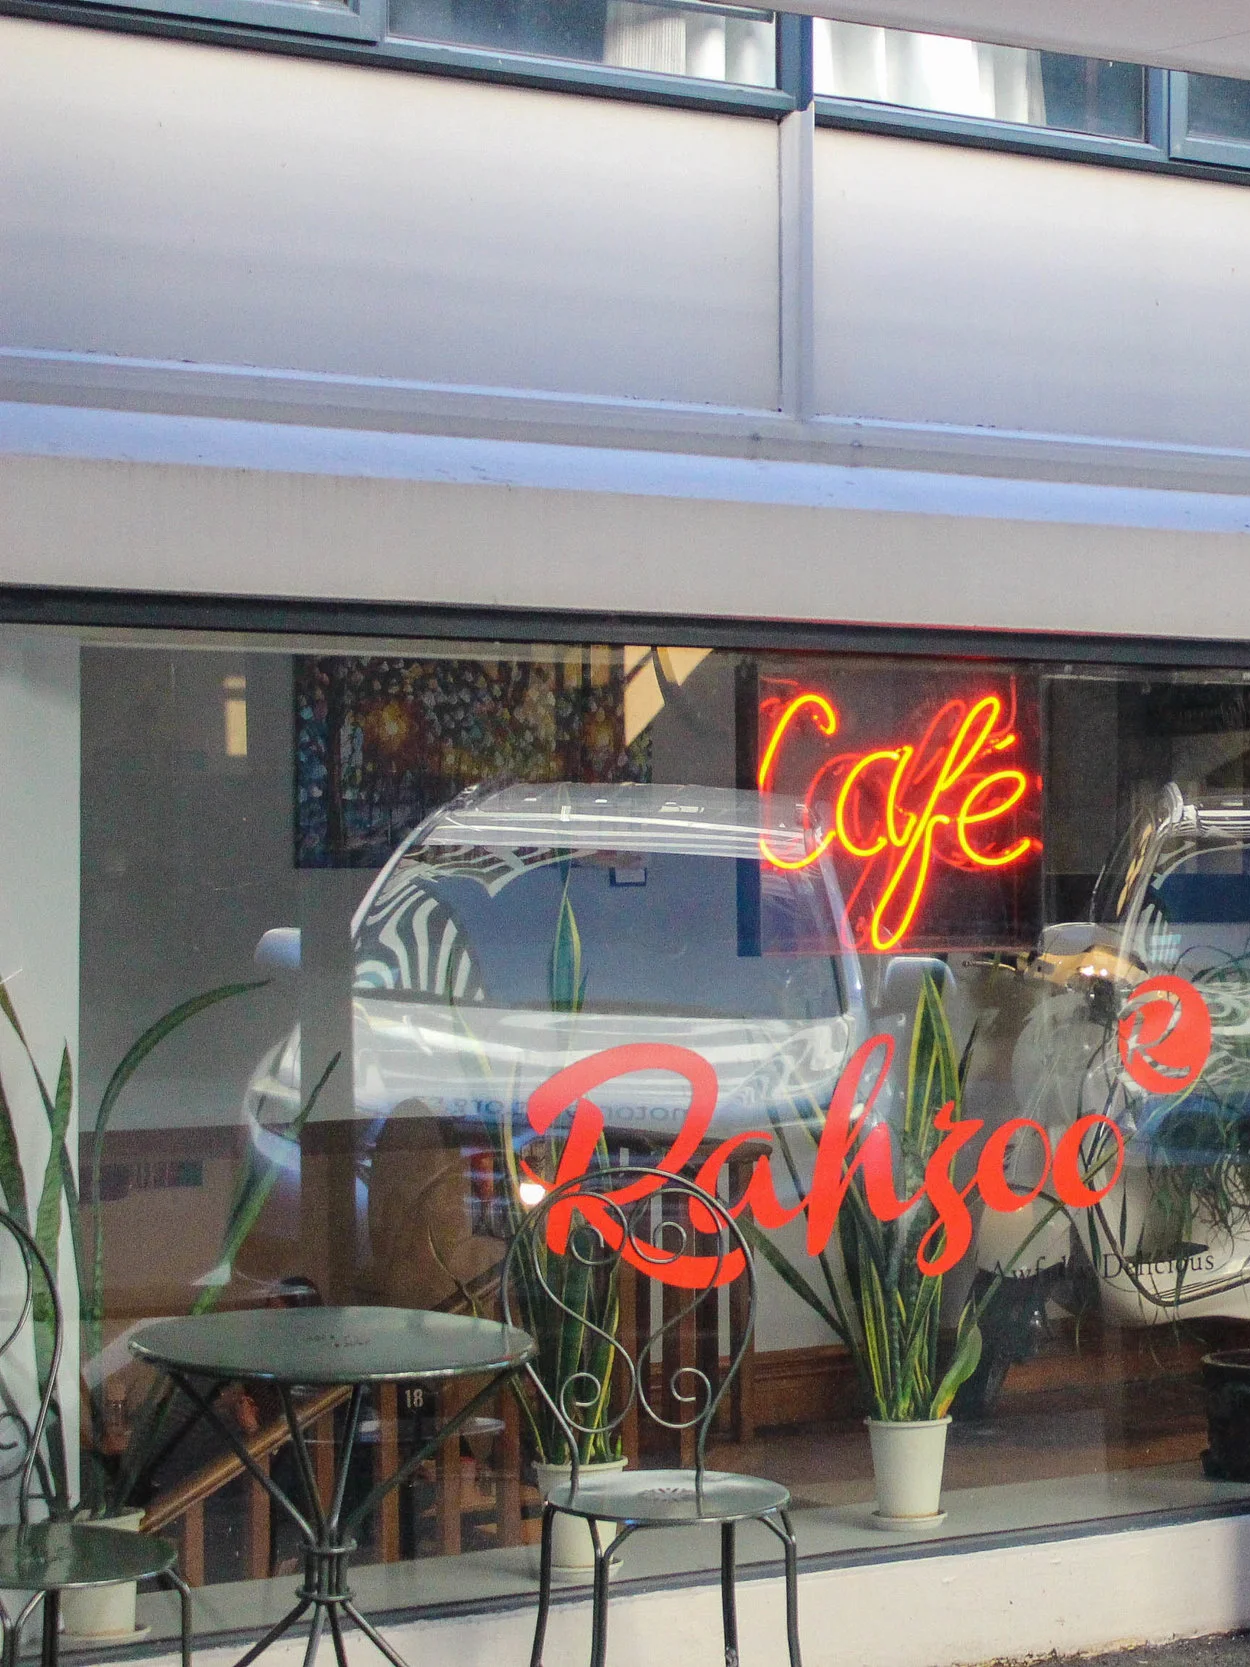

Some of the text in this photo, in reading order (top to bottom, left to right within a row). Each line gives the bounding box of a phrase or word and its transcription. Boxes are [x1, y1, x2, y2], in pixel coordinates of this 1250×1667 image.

[758, 693, 1031, 950] Café
[1117, 987, 1192, 1079] R
[404, 1387, 424, 1408] 18
